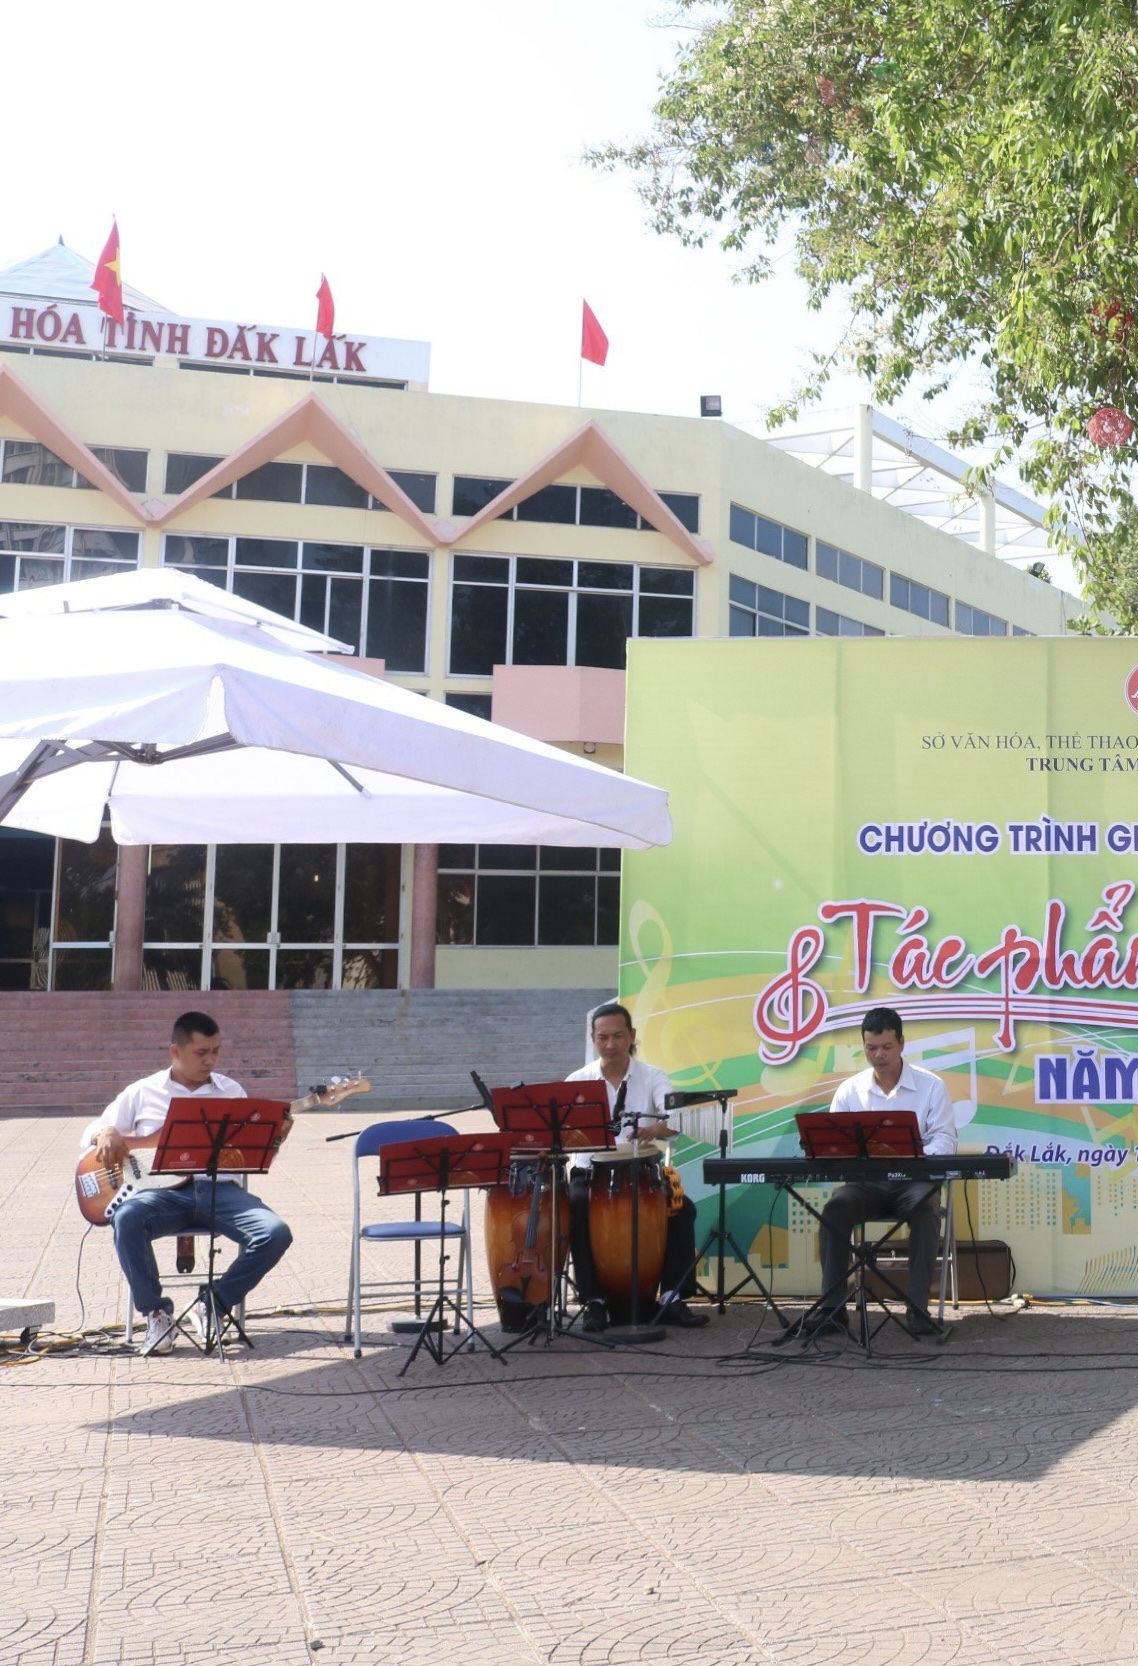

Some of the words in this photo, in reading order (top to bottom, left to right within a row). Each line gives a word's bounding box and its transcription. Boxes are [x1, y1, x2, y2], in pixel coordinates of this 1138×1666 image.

[10, 304, 86, 344] HÓA
[100, 311, 191, 354] TỈNH
[204, 324, 280, 364] ĐẮK
[293, 333, 367, 372] LẮK
[921, 732, 946, 750] SỞ
[950, 732, 991, 750] VĂN
[996, 731, 1041, 751] HÓA,
[1046, 731, 1082, 750] THỂ
[1087, 735, 1138, 750] THAO
[1026, 757, 1094, 772] TRUNG
[859, 821, 999, 853] CHƯƠNG
[1008, 816, 1097, 852] TRÌNH
[819, 900, 976, 992] Tác
[1030, 1143, 1072, 1165] Lắk,
[1077, 1145, 1129, 1167] ngày
[741, 1173, 765, 1183] KORG
